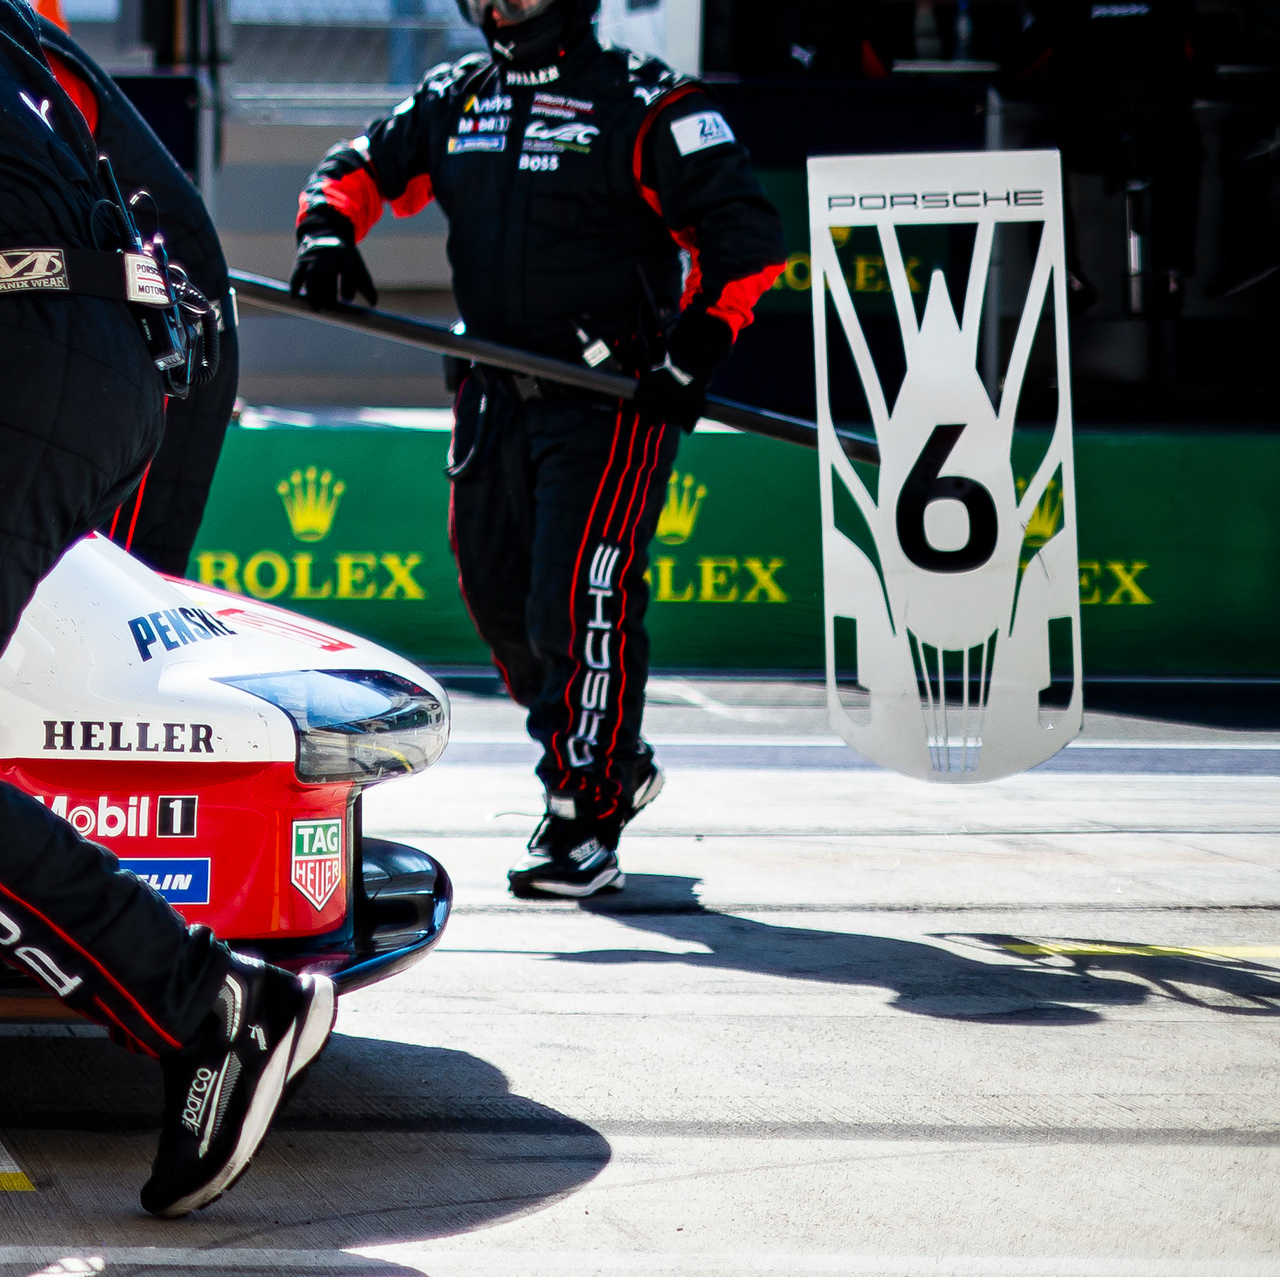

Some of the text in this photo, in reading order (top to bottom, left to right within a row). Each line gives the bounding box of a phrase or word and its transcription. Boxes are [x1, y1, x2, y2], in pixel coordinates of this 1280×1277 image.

[519, 153, 561, 171] BOSS
[827, 190, 1045, 212] PORSCHE
[31, 275, 66, 290] WEAR
[895, 423, 999, 574] 6
[196, 550, 427, 601] ROLEX
[643, 556, 790, 604] LEX
[128, 606, 239, 662] PENSKE
[42, 719, 215, 754] HELLER
[297, 826, 339, 854] TAG
[295, 859, 340, 906] HEUER
